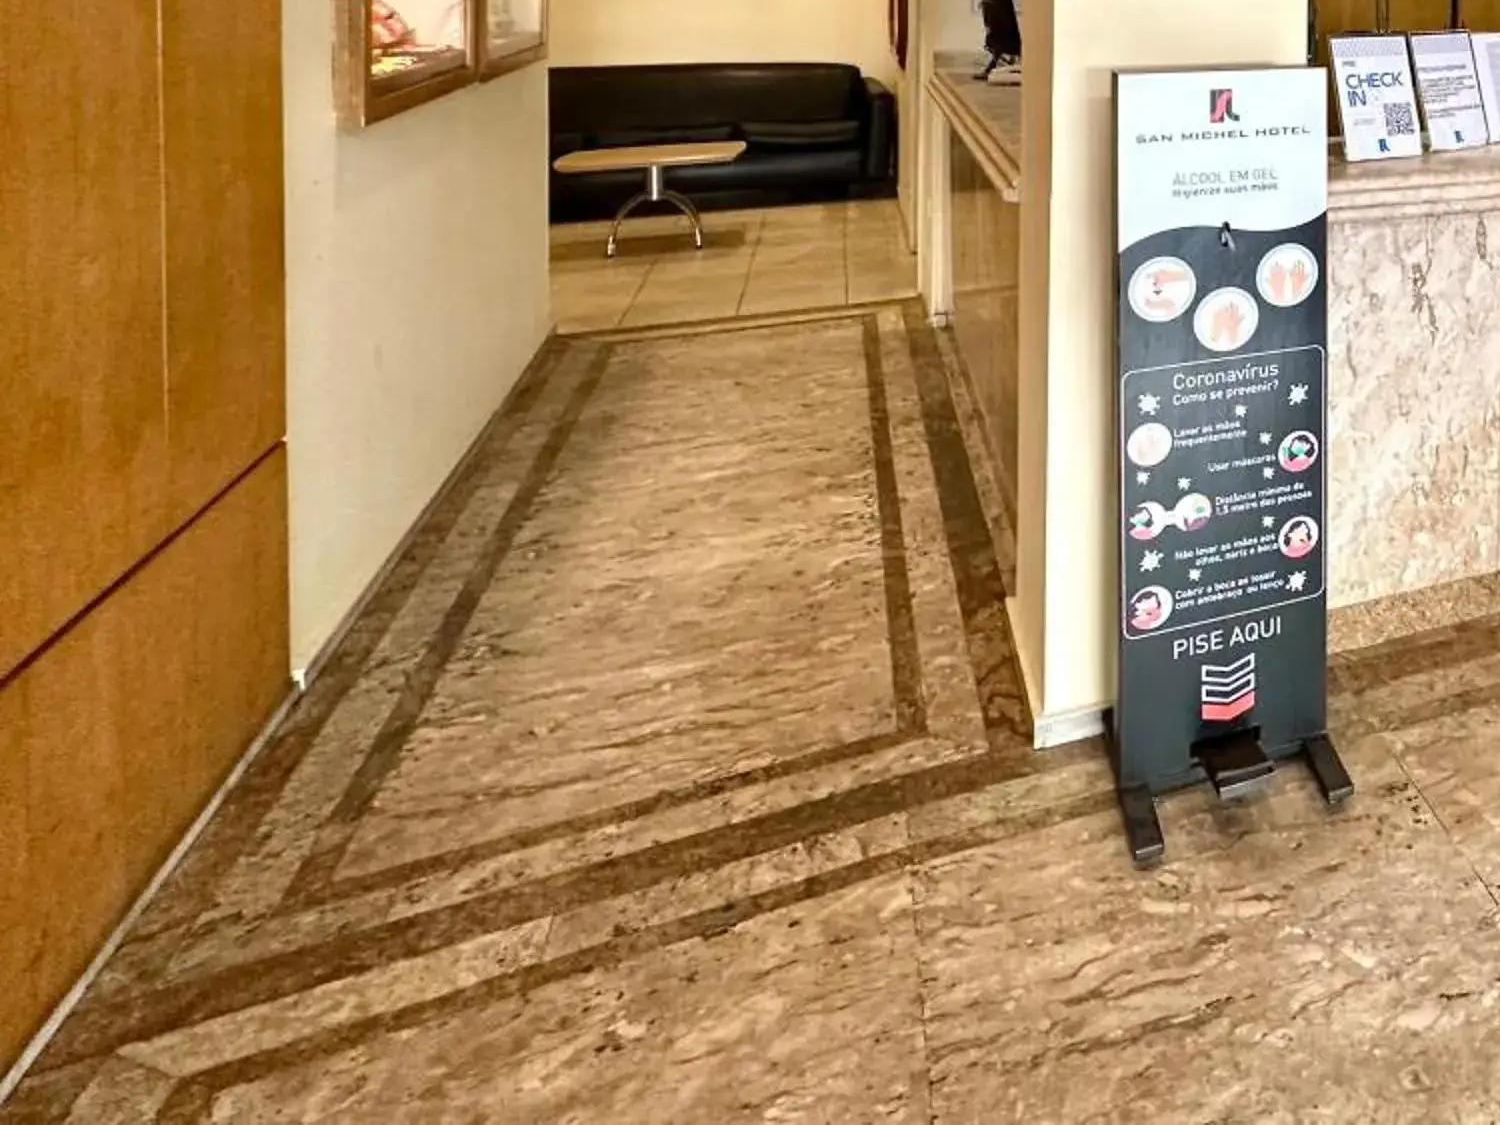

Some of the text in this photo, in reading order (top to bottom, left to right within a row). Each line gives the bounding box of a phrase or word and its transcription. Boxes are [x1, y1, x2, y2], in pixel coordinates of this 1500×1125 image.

[1345, 71, 1403, 89] CHECK
[1347, 90, 1367, 107] IN
[1135, 125, 1311, 144] SAN MICHEL HOTEL
[1229, 169, 1249, 182] EM
[1173, 362, 1279, 390] Coronavírus
[1173, 379, 1279, 406] Como se prevenir?
[1172, 615, 1281, 660] PISE AQUI
